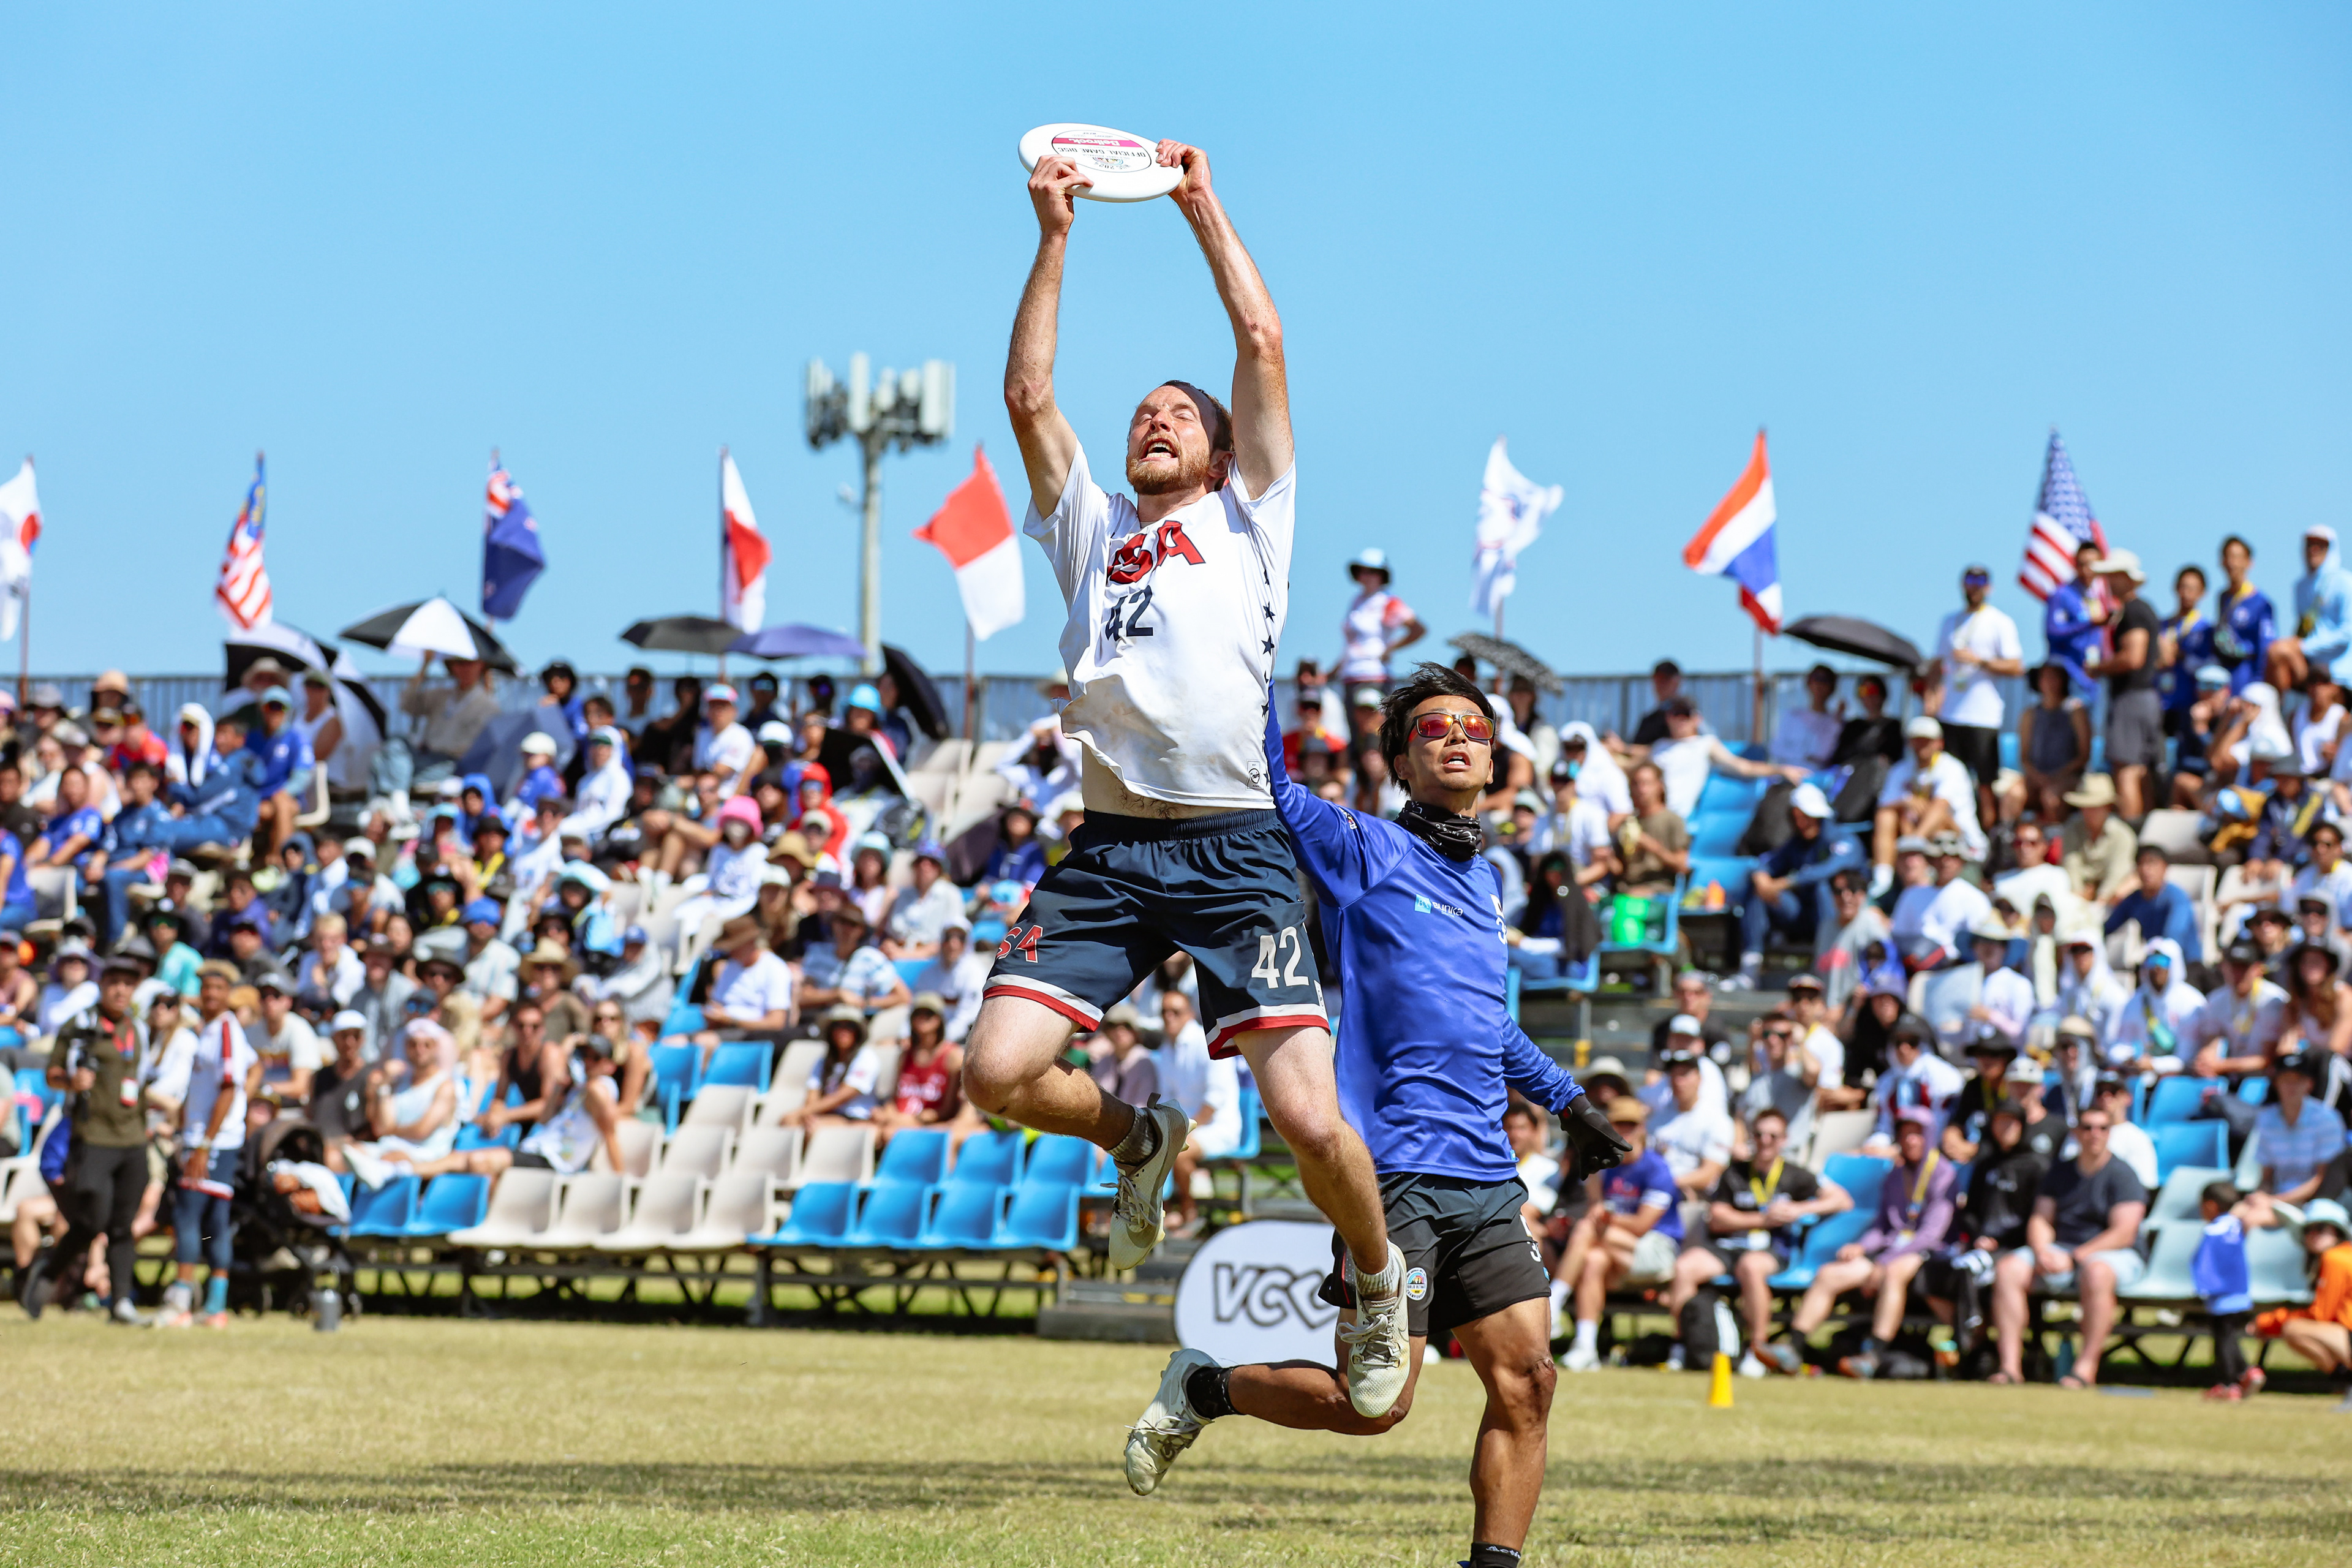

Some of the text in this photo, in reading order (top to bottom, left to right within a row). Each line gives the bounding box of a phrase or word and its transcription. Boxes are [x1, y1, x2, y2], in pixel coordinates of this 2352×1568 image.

[1106, 519, 1207, 585] SA
[1105, 584, 1154, 642] 42
[995, 924, 1043, 963] SA
[1496, 916, 1507, 945] 3
[1251, 925, 1310, 989] 42
[1527, 1241, 1542, 1262] 3
